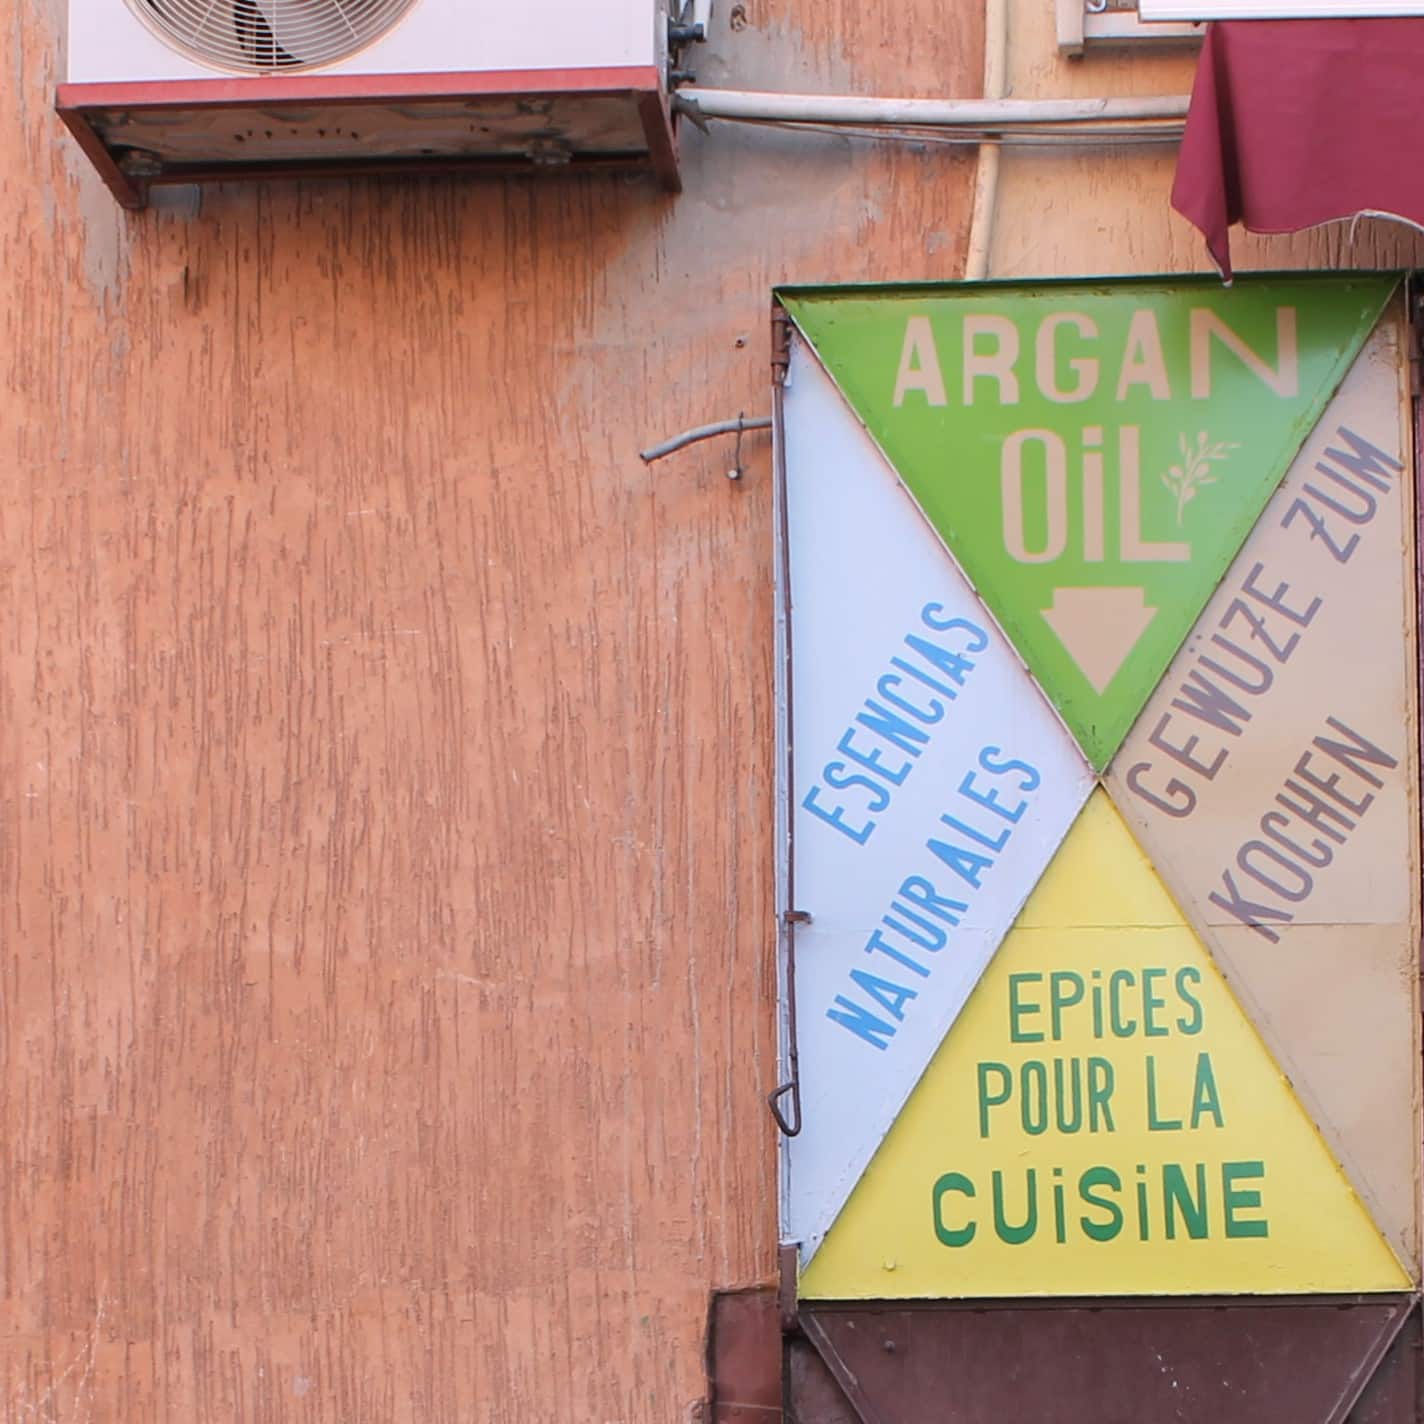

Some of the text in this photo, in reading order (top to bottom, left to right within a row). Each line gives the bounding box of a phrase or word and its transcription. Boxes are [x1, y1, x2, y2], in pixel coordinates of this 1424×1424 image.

[892, 305, 1301, 407] ARGAN
[801, 601, 989, 846] ESENCIAS
[1125, 425, 1406, 820] GEWÜZE ZUM
[1208, 715, 1399, 945] KOCHEN
[976, 1052, 1225, 1139] POUR LA
